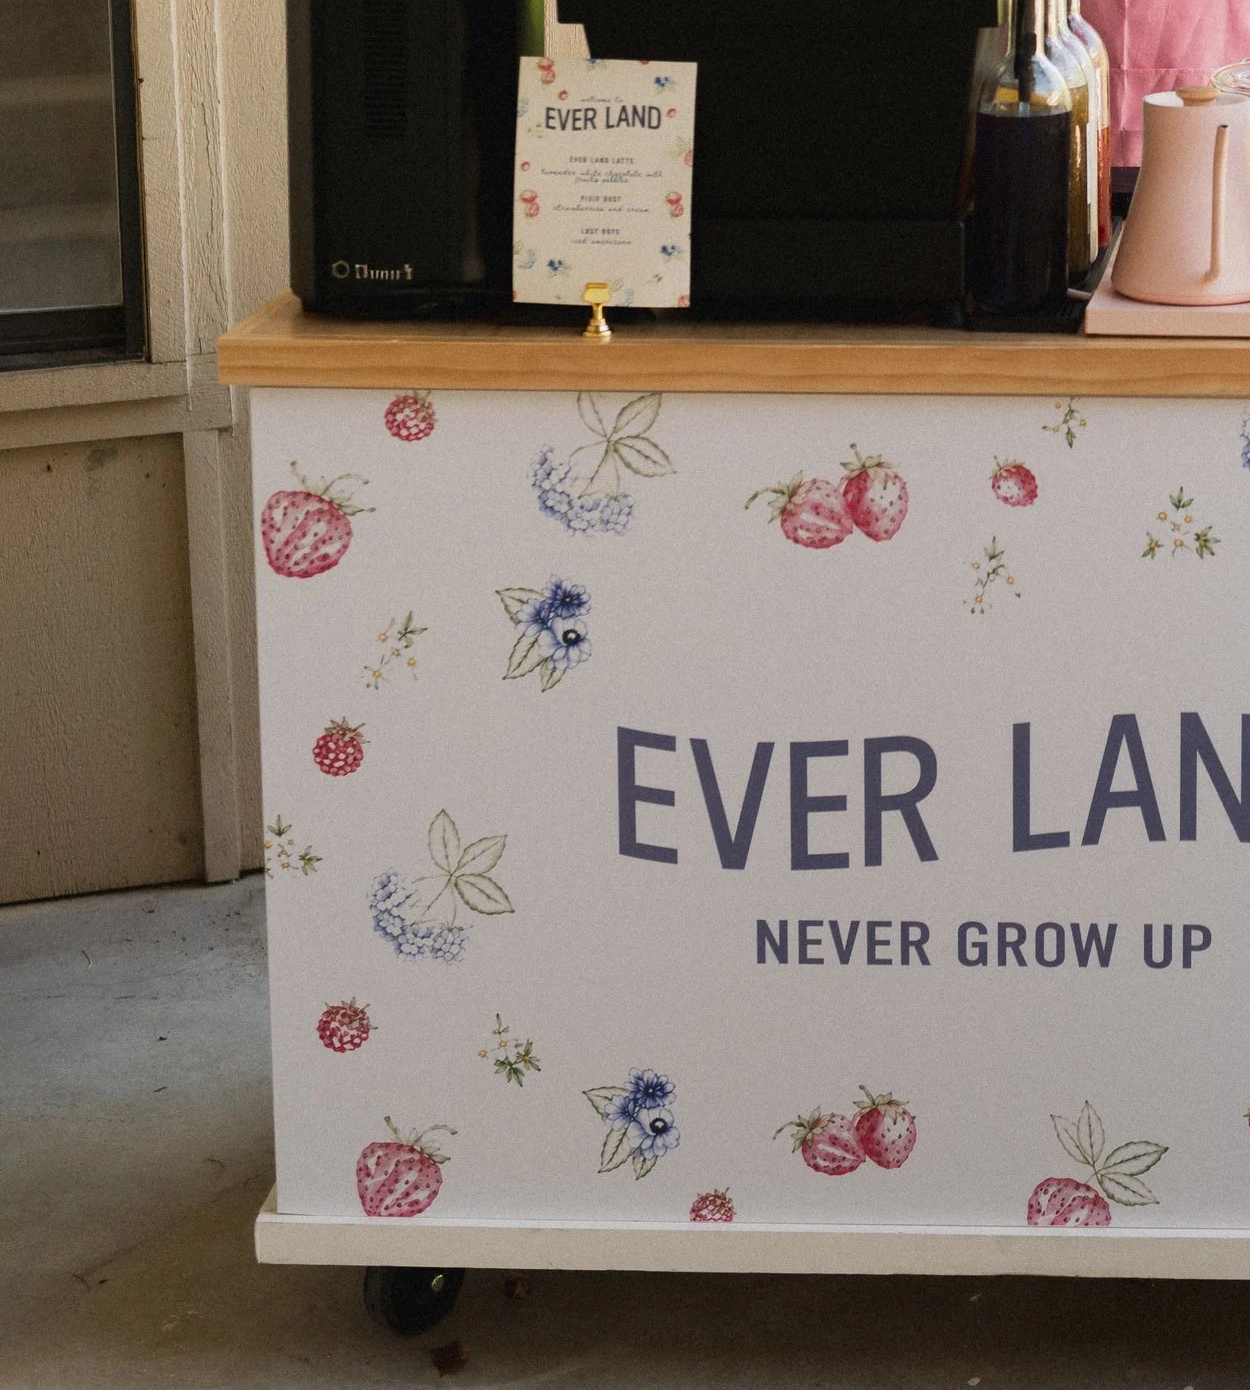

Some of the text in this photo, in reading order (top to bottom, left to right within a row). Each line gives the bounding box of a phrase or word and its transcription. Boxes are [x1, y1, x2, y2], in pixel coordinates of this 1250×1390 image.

[545, 105, 661, 131] EVER LAND
[617, 725, 940, 871] EVER
[756, 919, 1213, 970] NEVER GROW UP
